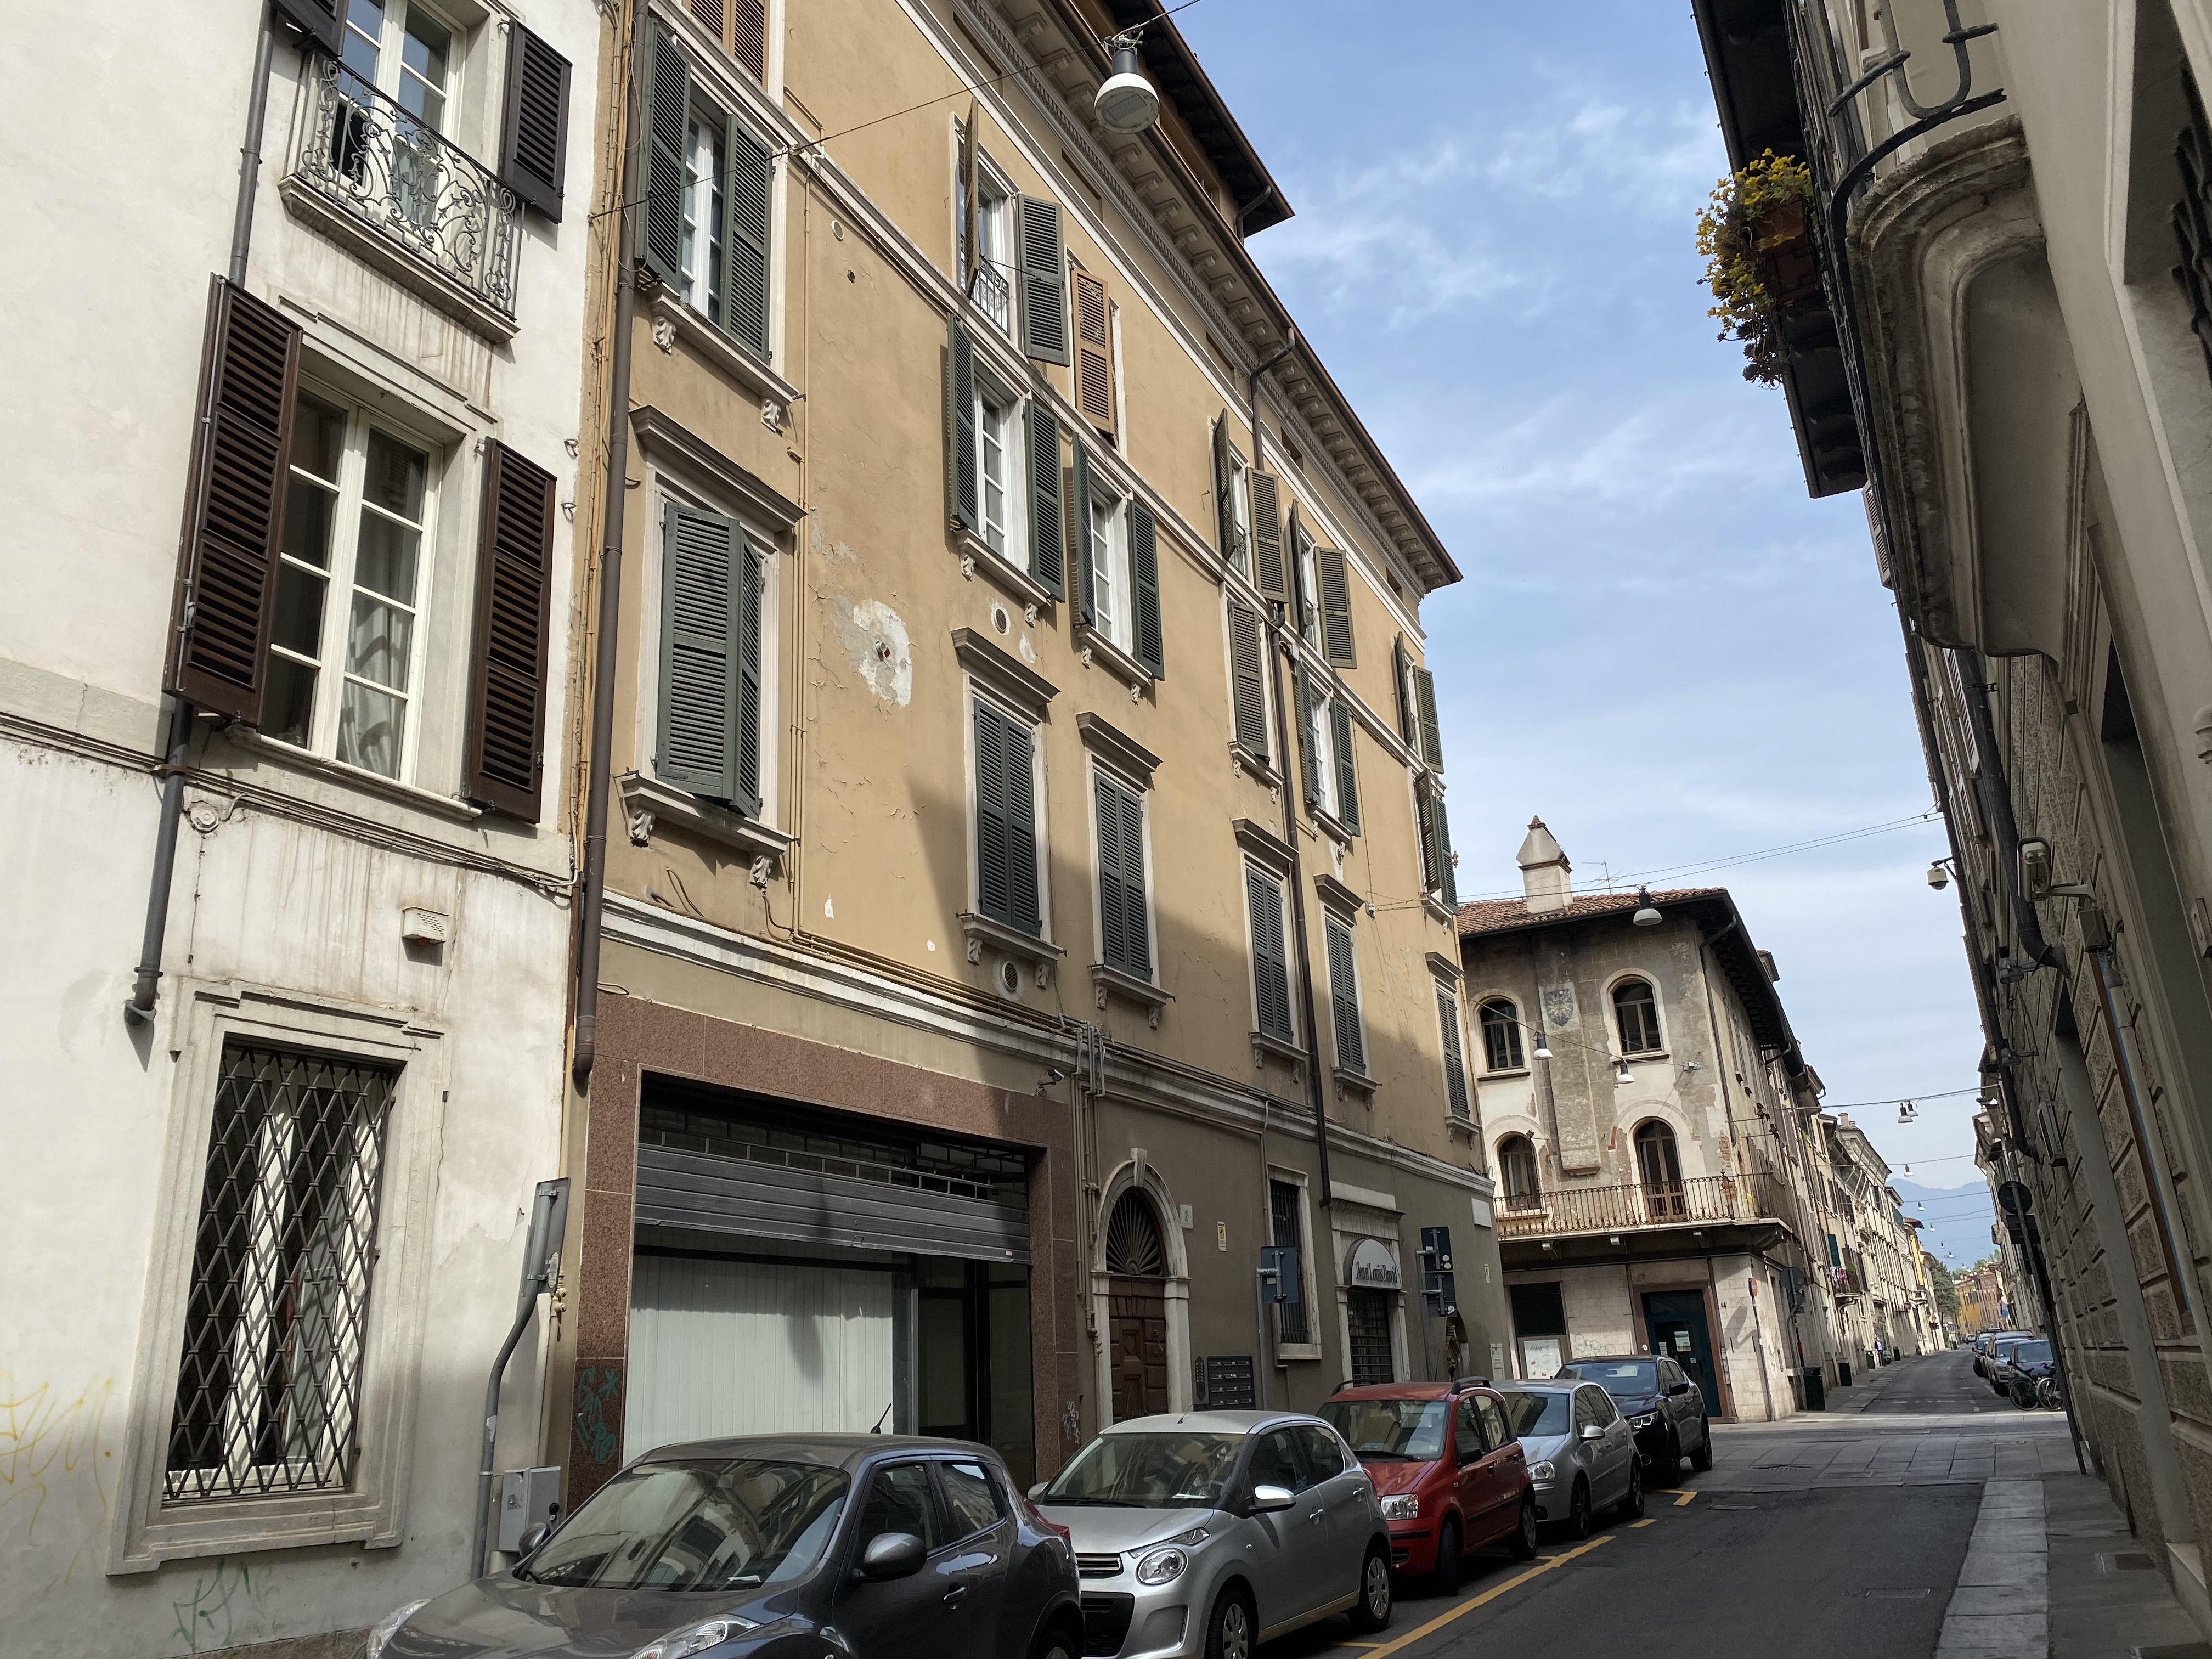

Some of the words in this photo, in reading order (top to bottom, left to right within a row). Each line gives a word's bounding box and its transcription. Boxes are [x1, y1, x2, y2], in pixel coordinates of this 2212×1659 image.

[1184, 1210, 1188, 1222] 2
[1356, 1261, 1369, 1280] Jean
[1368, 1263, 1383, 1282] Louis
[1382, 1265, 1397, 1283] David
